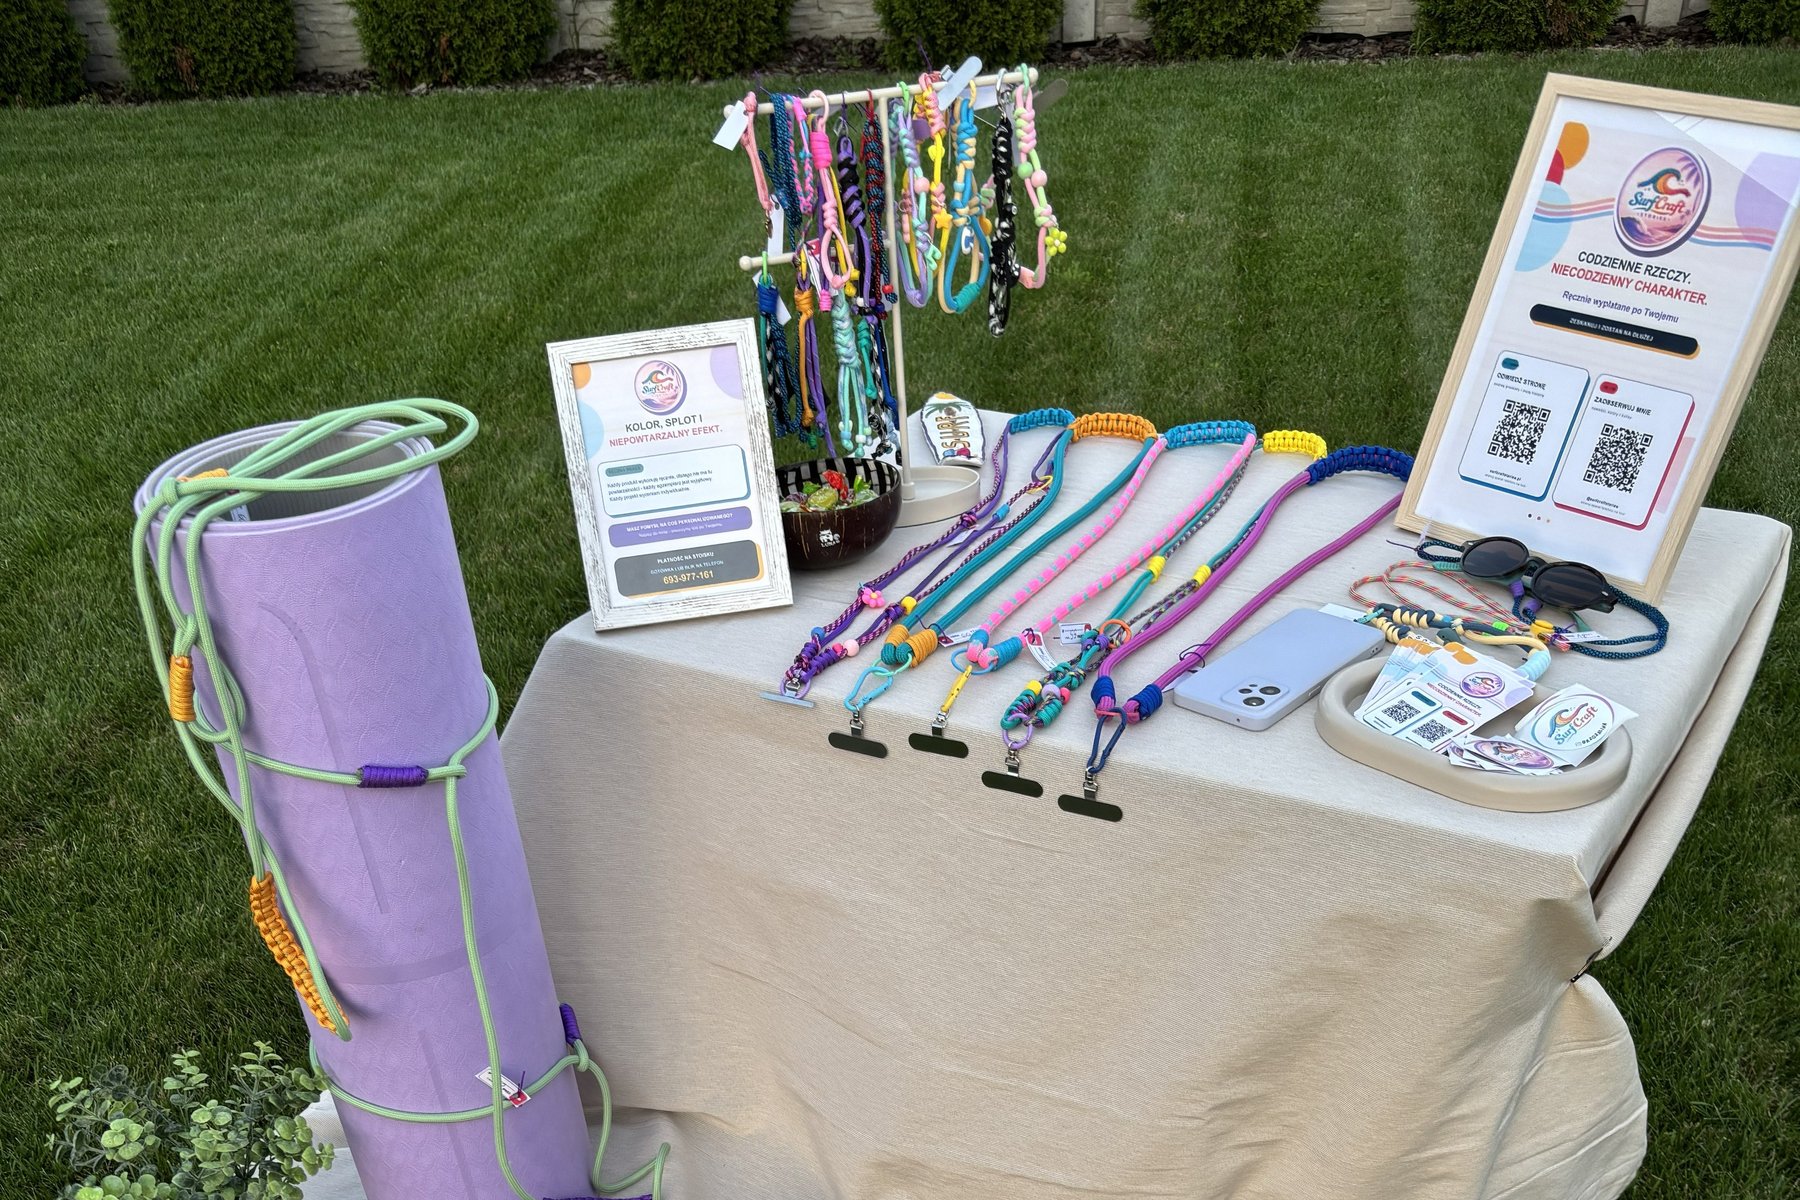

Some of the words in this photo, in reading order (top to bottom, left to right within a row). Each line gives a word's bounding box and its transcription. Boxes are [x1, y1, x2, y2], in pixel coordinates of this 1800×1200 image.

[1628, 191, 1685, 215] SurfCraft
[1578, 251, 1643, 274] CODZIENNE
[1644, 263, 1691, 284] RZECZY.
[1551, 262, 1633, 289] NIECODZIENNY
[1634, 280, 1708, 305] CHARAKTER.
[1562, 290, 1592, 305] Ręcznie
[1631, 307, 1642, 316] po
[1644, 308, 1679, 323] Twojemu
[1623, 329, 1631, 337] NA
[1593, 396, 1635, 411] ZAOBSERWUJ
[1635, 407, 1652, 416] MNIE
[625, 420, 663, 433] KOLOR,
[665, 415, 697, 427] SPLOT
[699, 414, 703, 423] I
[609, 429, 690, 447] NIEPOWTARZALNY
[692, 424, 723, 436] EFEKT.
[656, 555, 684, 564] PŁATNOŚĆ
[663, 570, 714, 585] 693-977-161
[1554, 706, 1598, 744] SurfCraft
